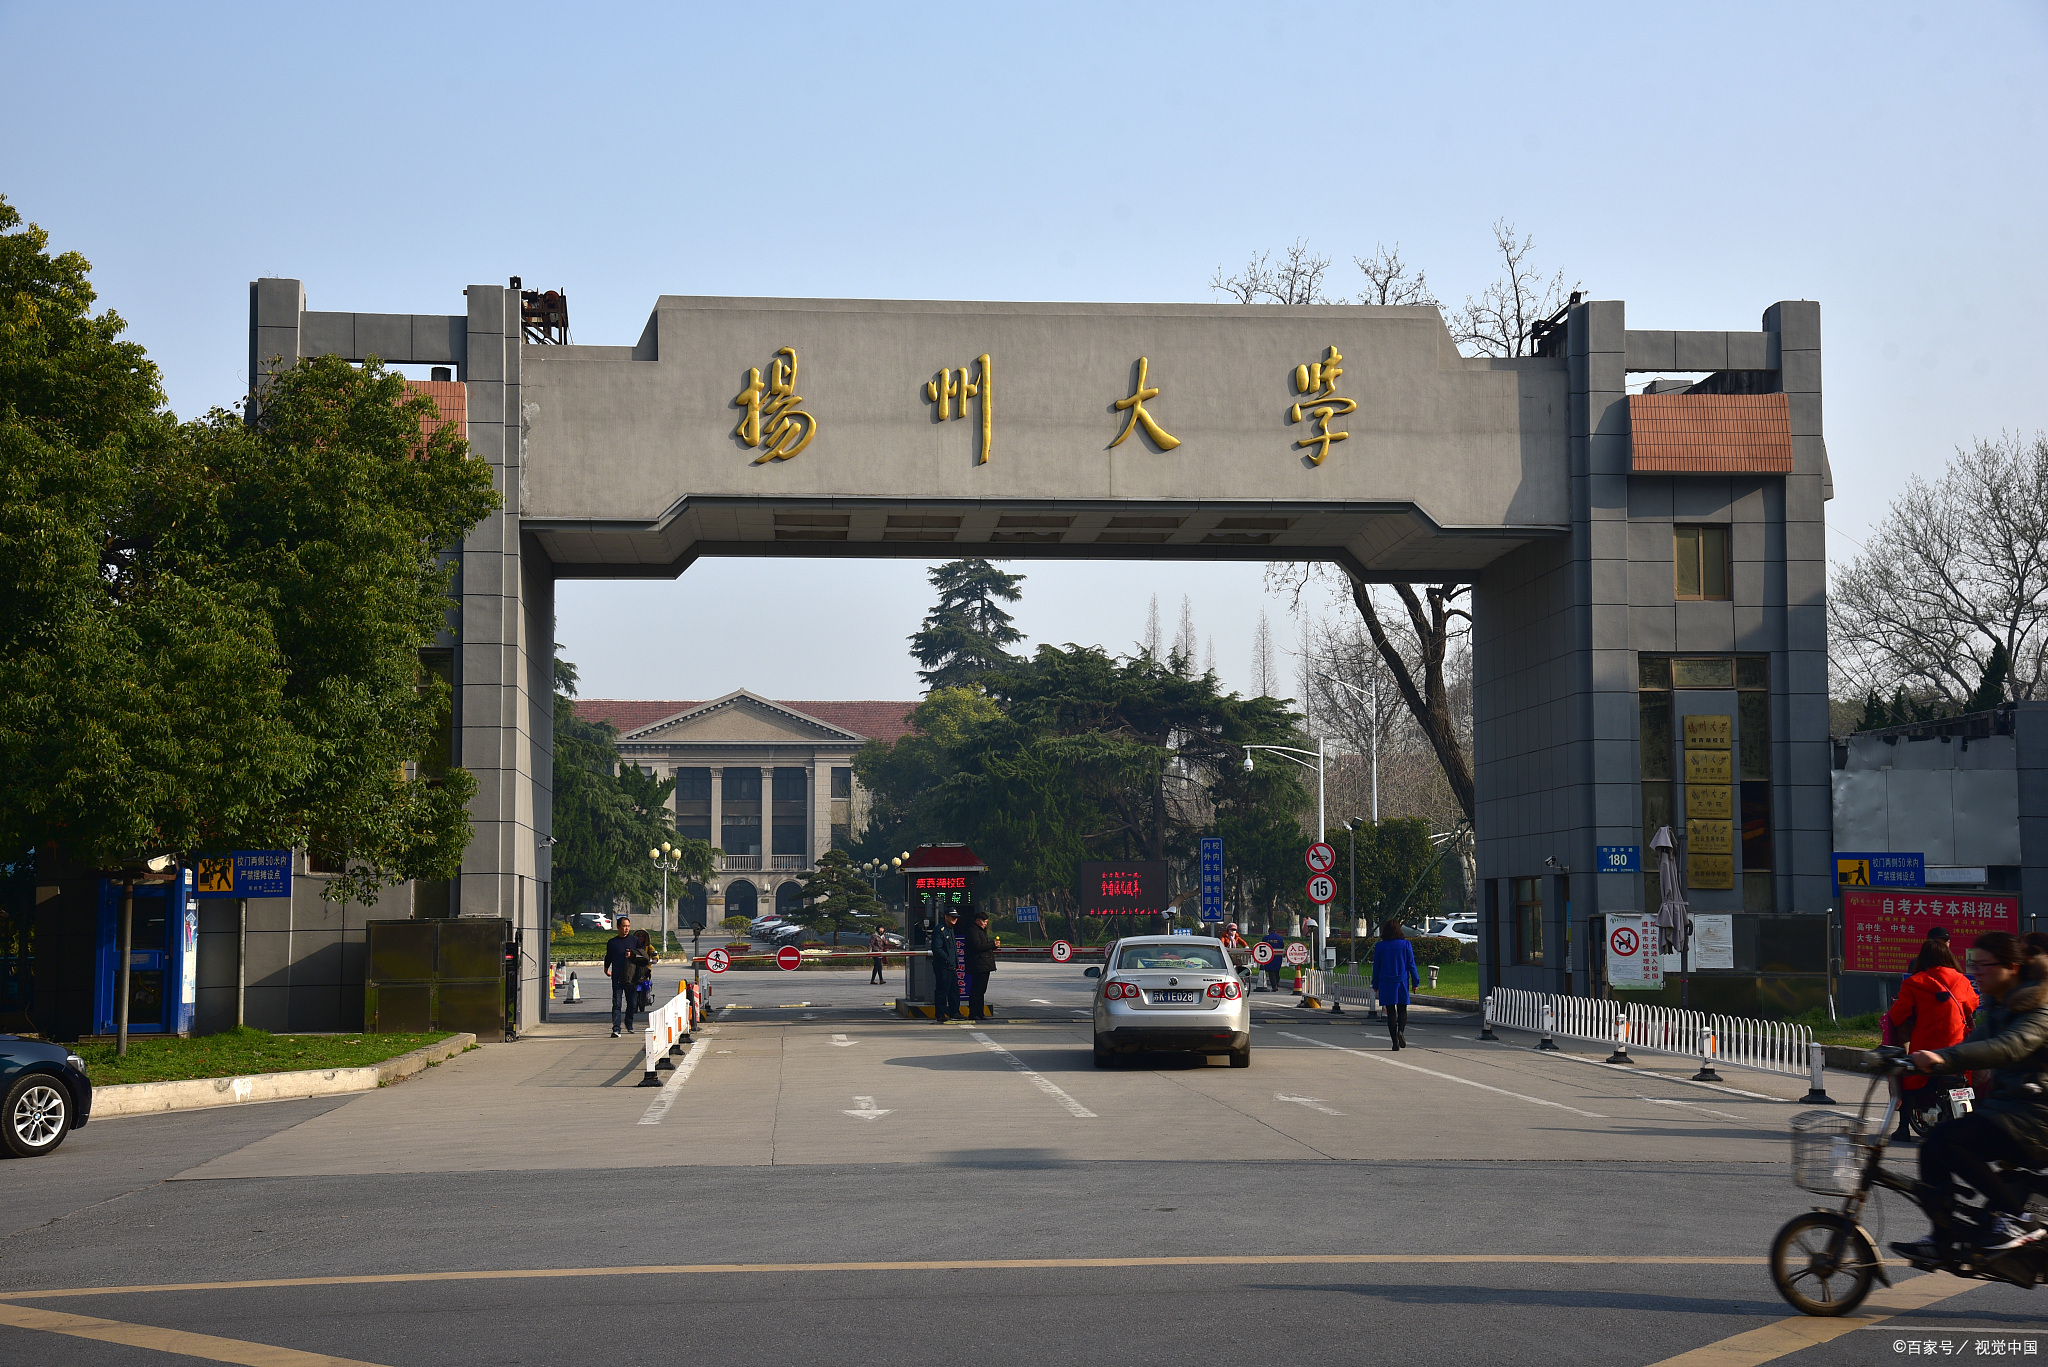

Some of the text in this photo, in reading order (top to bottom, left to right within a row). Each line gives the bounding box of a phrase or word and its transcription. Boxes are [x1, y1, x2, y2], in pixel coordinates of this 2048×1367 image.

[237, 855, 287, 867] 校门两侧50米内
[1609, 854, 1627, 865] 180
[1872, 857, 1919, 868] 校门两侧50米内
[240, 869, 281, 880] 严禁摆摊设点
[1877, 871, 1915, 881] 严禁摆摊设点
[1313, 881, 1328, 896] 15
[1882, 898, 2008, 918] 自考大专本科招生
[1057, 943, 1066, 956] 5
[1259, 946, 1267, 957] 5
